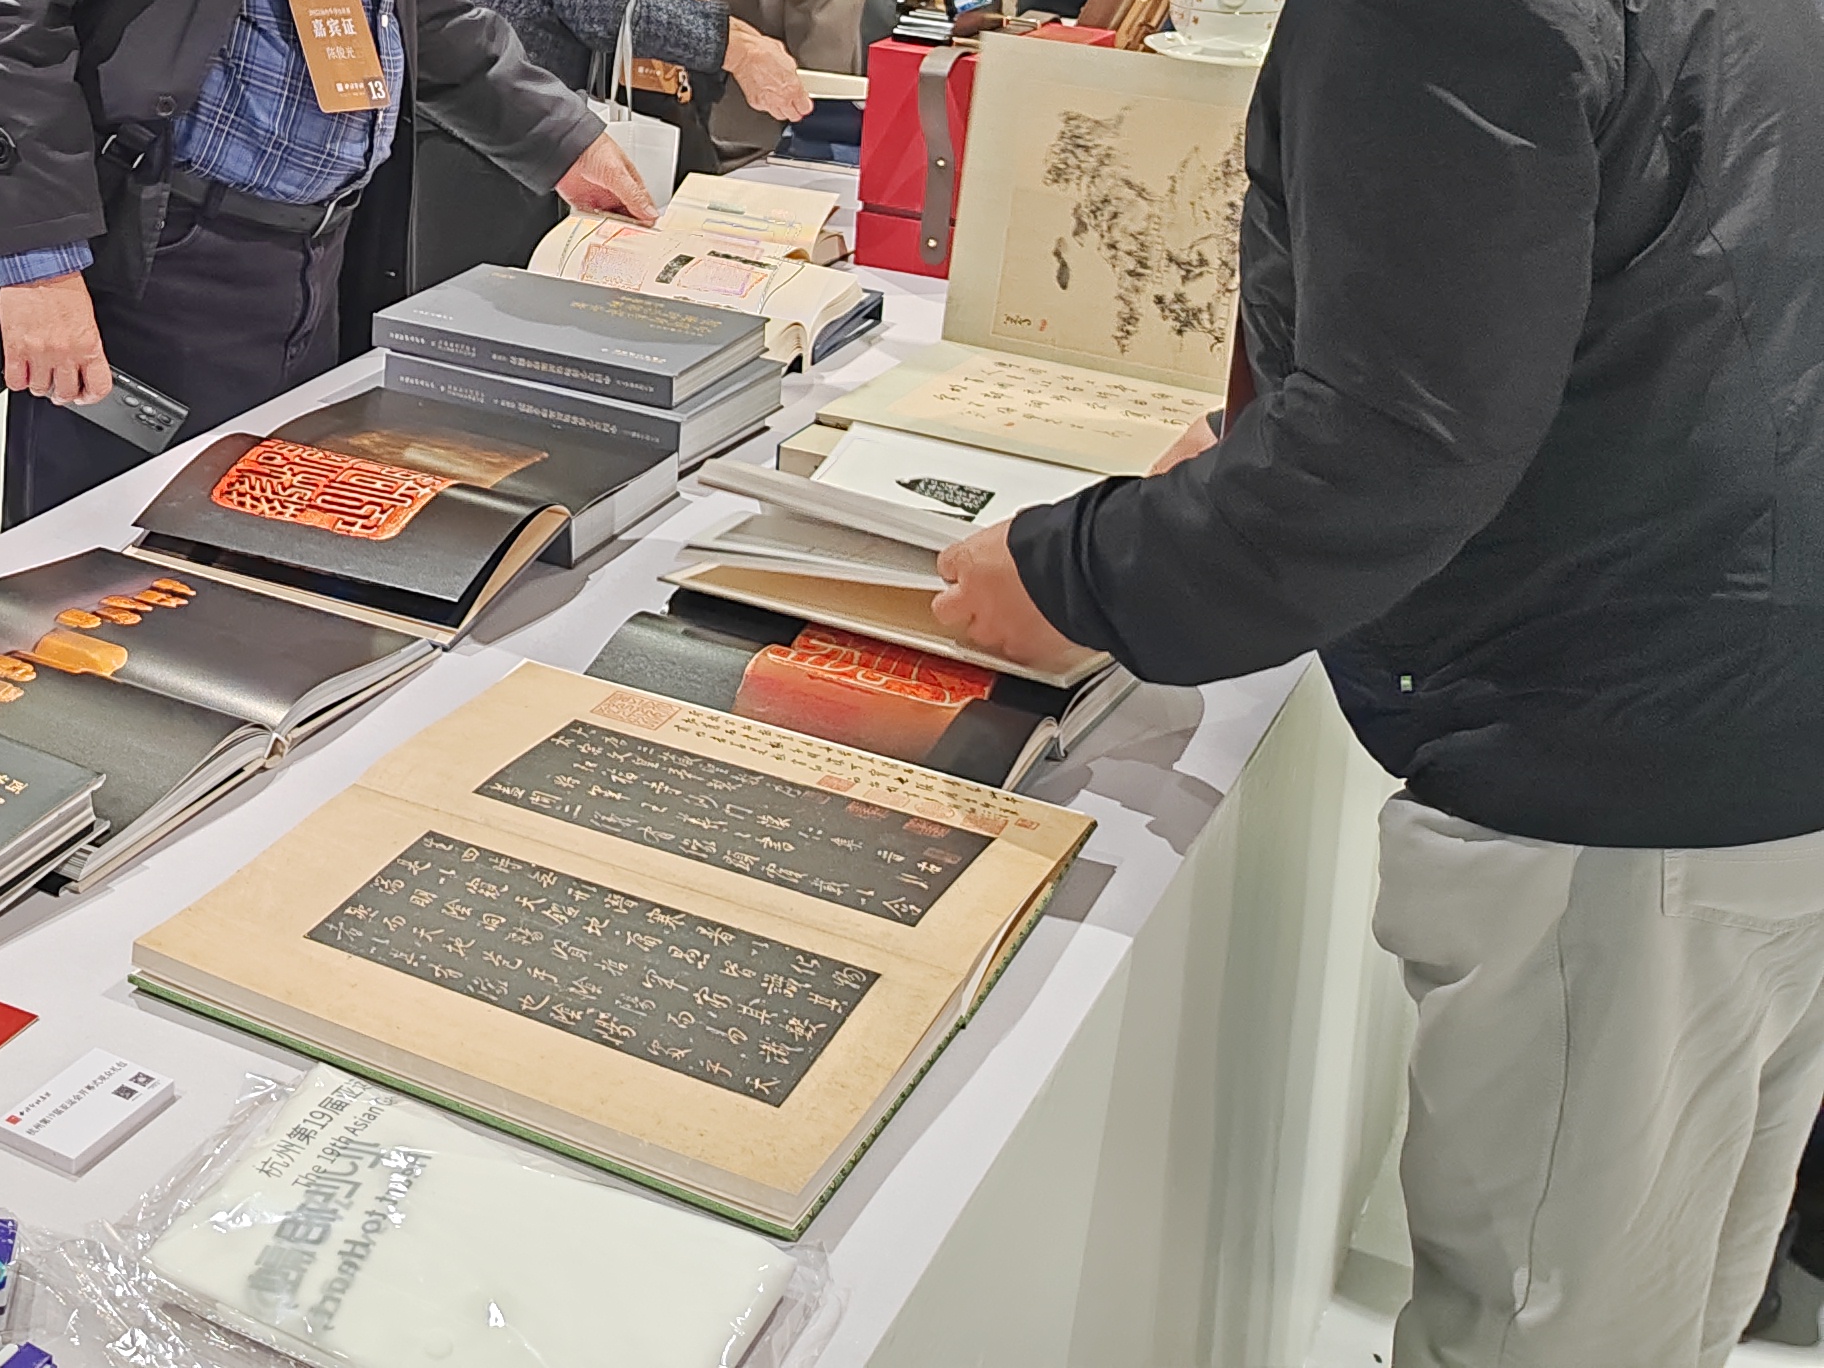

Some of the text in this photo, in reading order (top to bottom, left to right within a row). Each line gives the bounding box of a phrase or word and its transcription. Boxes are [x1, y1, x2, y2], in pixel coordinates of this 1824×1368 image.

[311, 17, 357, 38] 嘉宾证
[367, 80, 386, 100] 13
[291, 1162, 328, 1189] The
[320, 1135, 354, 1168] 19th
[350, 1104, 386, 1138] Asian
